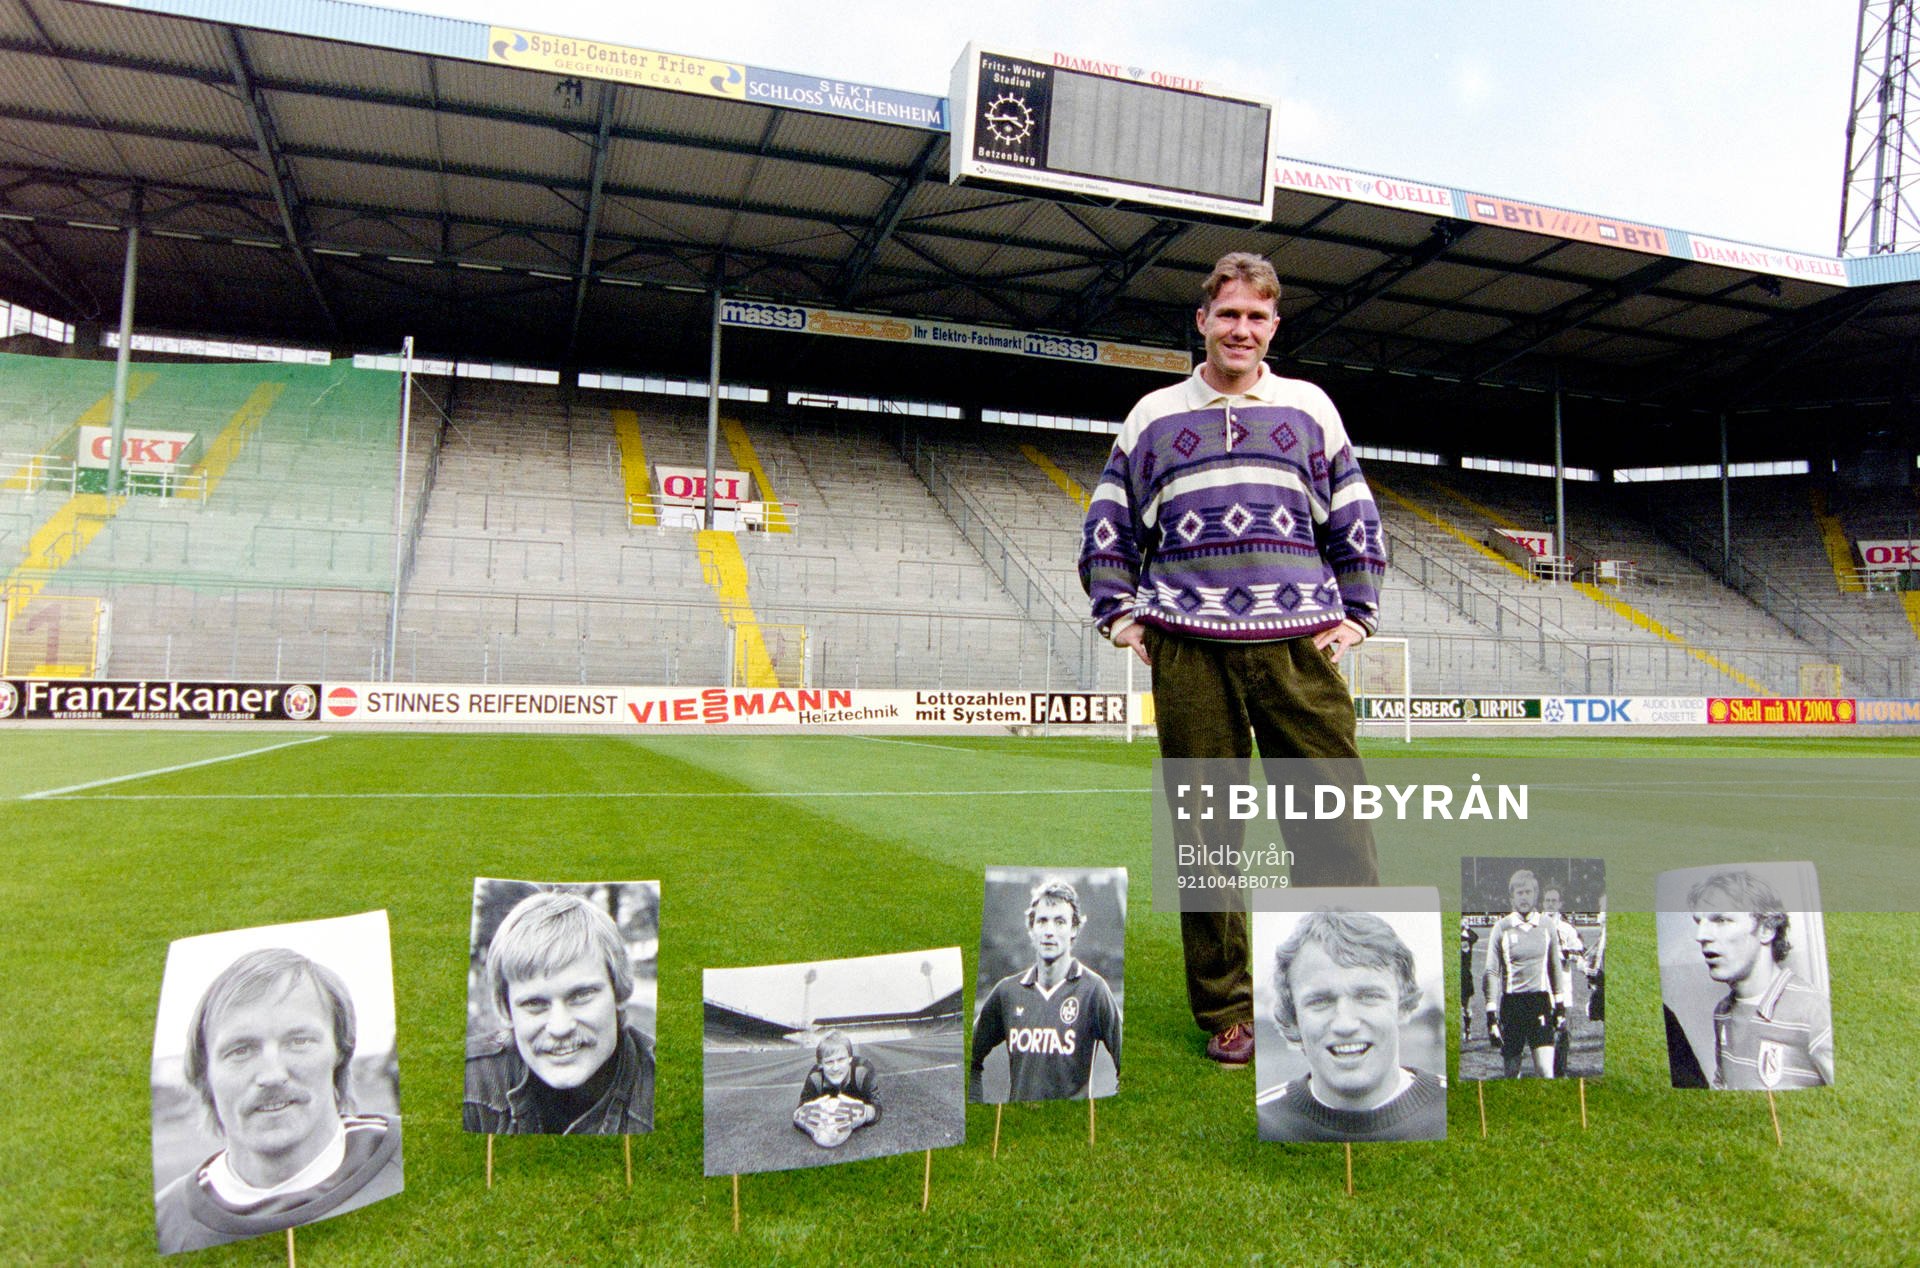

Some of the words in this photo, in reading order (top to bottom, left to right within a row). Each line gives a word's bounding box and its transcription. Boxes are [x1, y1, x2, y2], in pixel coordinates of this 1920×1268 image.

[530, 36, 648, 67] Spiel-Center
[657, 55, 706, 77] Trier
[1053, 52, 1122, 77] DIAMANT
[554, 59, 643, 80] GEGENÜBER
[993, 72, 1031, 89] Stadion
[819, 80, 873, 99] SEKT
[749, 81, 824, 106] SCHLOSS
[828, 94, 942, 124] WACHENHEIM
[978, 146, 1036, 166] Betzenberg
[1274, 167, 1353, 193] IAMANT
[1375, 179, 1451, 207] QUELLE
[1502, 204, 1544, 228] BTI
[1622, 227, 1663, 250] BTI
[1693, 240, 1770, 268] DIAMANT
[1785, 255, 1845, 278] QUELLE
[722, 302, 804, 329] massa
[914, 325, 928, 340] Ihr
[932, 327, 1022, 350] Elektro-Fachmarkt
[1025, 335, 1096, 361] massa
[91, 435, 187, 464] OKI
[663, 475, 740, 500] OKI
[1507, 535, 1548, 558] KI
[28, 682, 280, 712] Franziskaner
[367, 692, 460, 713] STINNES
[469, 693, 619, 715] REIFENDIENST
[628, 688, 852, 724] VIESSMANN
[915, 691, 1026, 706] Lottozahlen
[1034, 695, 1125, 721] FABER
[799, 705, 900, 725] Heiztechnik
[915, 707, 946, 721] mit
[953, 707, 1027, 724] System.
[1564, 699, 1632, 722] TDK
[1651, 711, 1697, 722] CASSETTE
[1730, 700, 1762, 722] Shell
[1764, 701, 1785, 721] mit
[1787, 701, 1801, 721] M
[1538, 1014, 1546, 1027] 1
[1009, 1028, 1076, 1055] PORTAS
